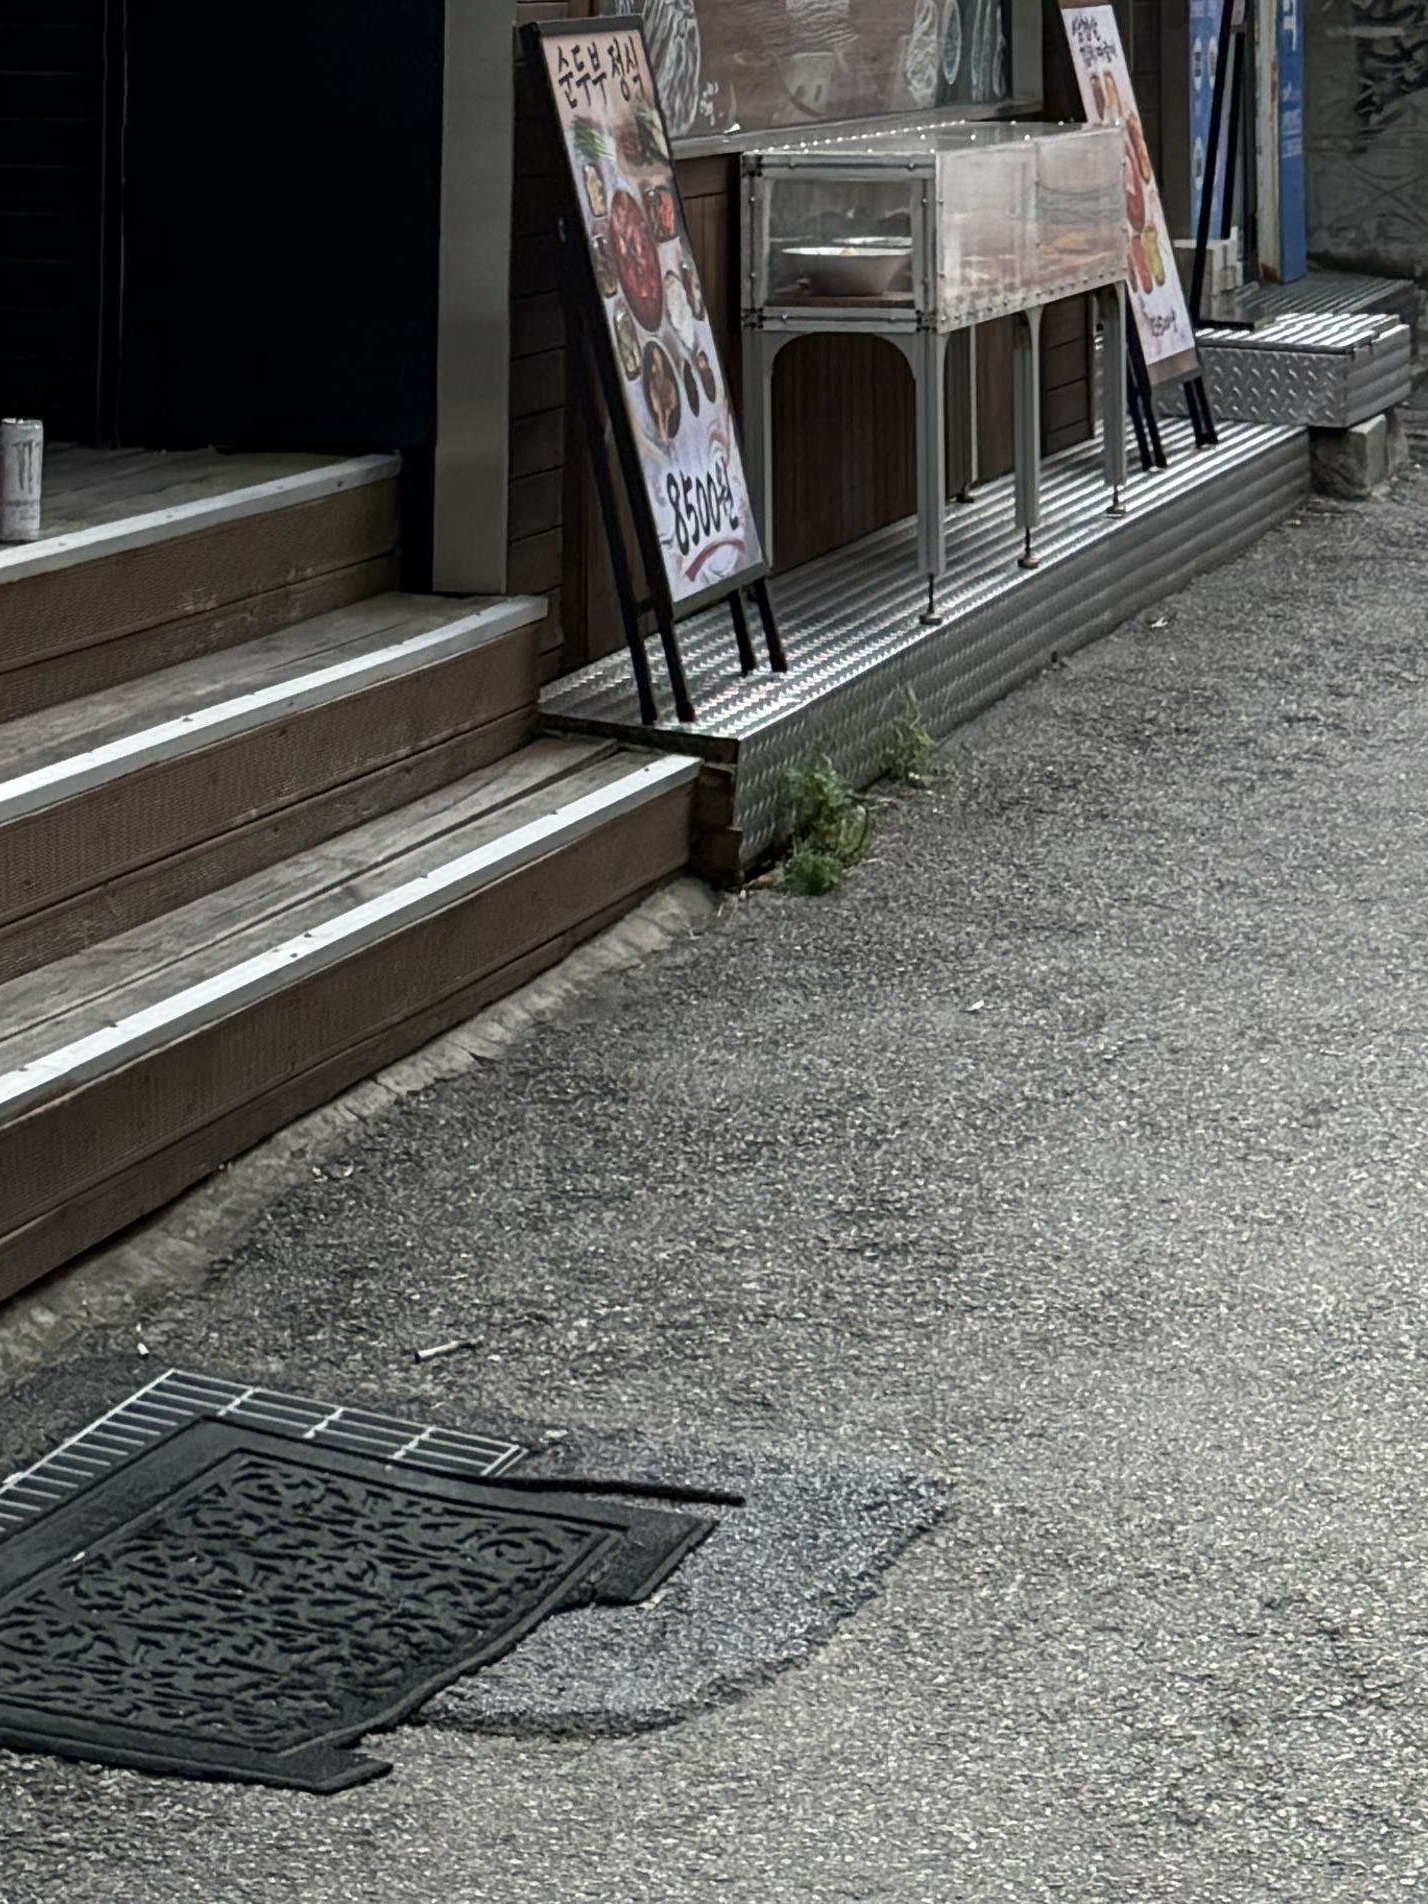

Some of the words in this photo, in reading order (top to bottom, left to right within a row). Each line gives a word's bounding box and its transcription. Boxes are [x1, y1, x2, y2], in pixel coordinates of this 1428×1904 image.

[557, 41, 608, 110] 순두부
[607, 35, 646, 103] 정식
[665, 455, 740, 557] 8500원
